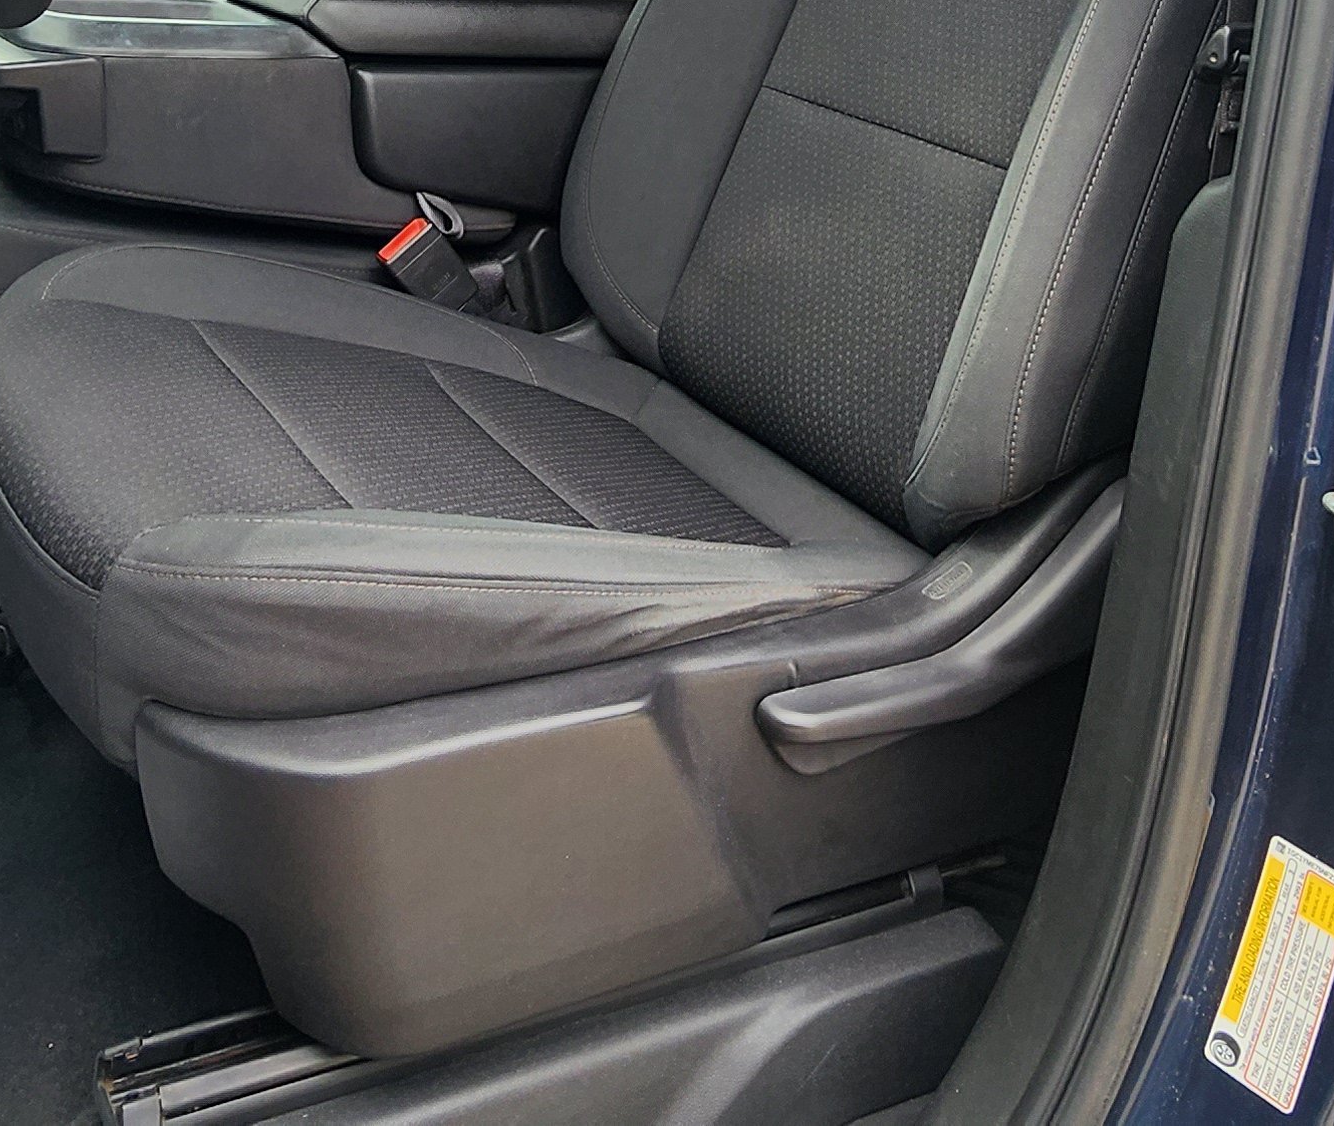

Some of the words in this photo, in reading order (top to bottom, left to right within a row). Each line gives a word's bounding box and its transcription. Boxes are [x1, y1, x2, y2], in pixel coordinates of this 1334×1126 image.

[1253, 874, 1280, 932] INFORMATION
[1242, 926, 1264, 969] LOADING
[1278, 969, 1292, 992] COLD
[1288, 919, 1307, 958] PRESSURE
[1236, 963, 1252, 987] AND
[1230, 982, 1246, 1005] TIRE
[1260, 1011, 1278, 1050] ORIGINAL
[1270, 995, 1283, 1016] SIZE
[1260, 1065, 1274, 1091] FRONT
[1271, 1076, 1283, 1099] REAR
